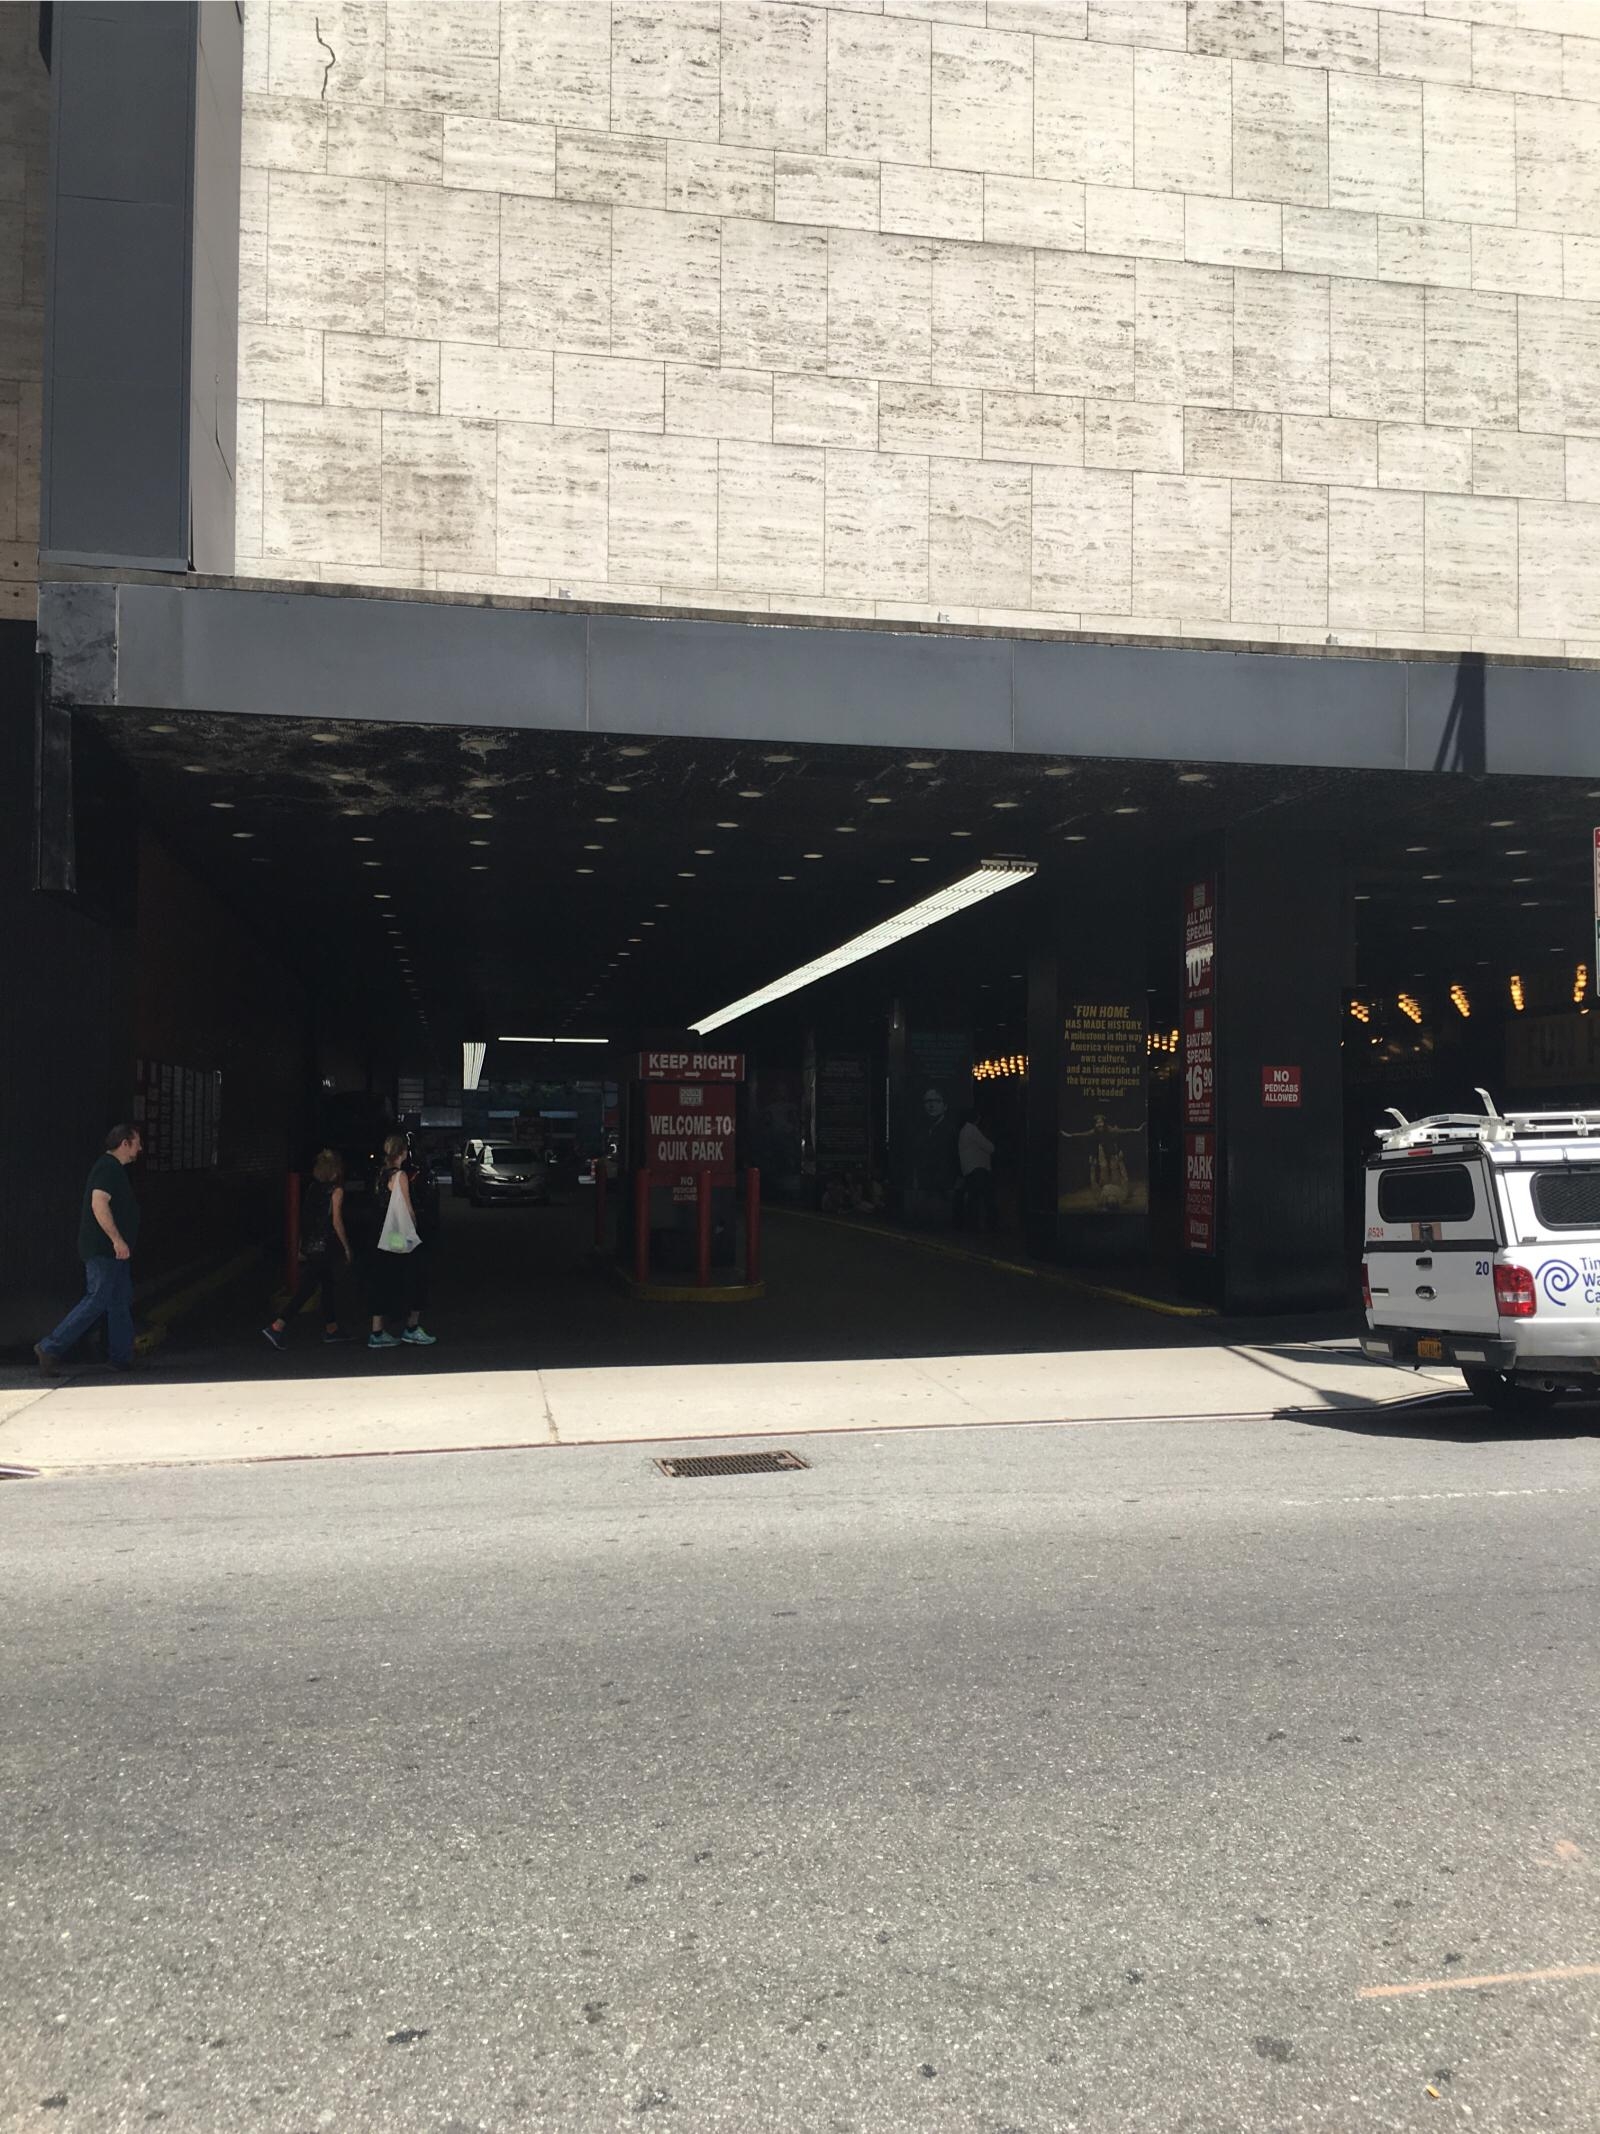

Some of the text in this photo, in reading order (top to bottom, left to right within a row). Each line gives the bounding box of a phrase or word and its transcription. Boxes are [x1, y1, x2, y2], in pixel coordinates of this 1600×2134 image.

[1186, 906, 1213, 927] ALL DAY
[1186, 922, 1212, 941] SPECIAL
[1065, 1019, 1081, 1029] HAS
[1083, 1019, 1105, 1029] MADE
[649, 1054, 737, 1070] KEEP RIGHT
[1187, 1048, 1212, 1064] SPECIAL
[1185, 1065, 1203, 1100] 16
[1273, 1070, 1290, 1082] NO
[1264, 1084, 1299, 1093] PEDICABS
[1265, 1093, 1298, 1102] ALLOWED
[650, 1115, 732, 1136] WELCOME TO
[658, 1141, 724, 1161] QUIK PARK
[1187, 1155, 1213, 1180] PARK
[680, 1176, 694, 1186] NO
[1475, 1261, 1490, 1276] 20
